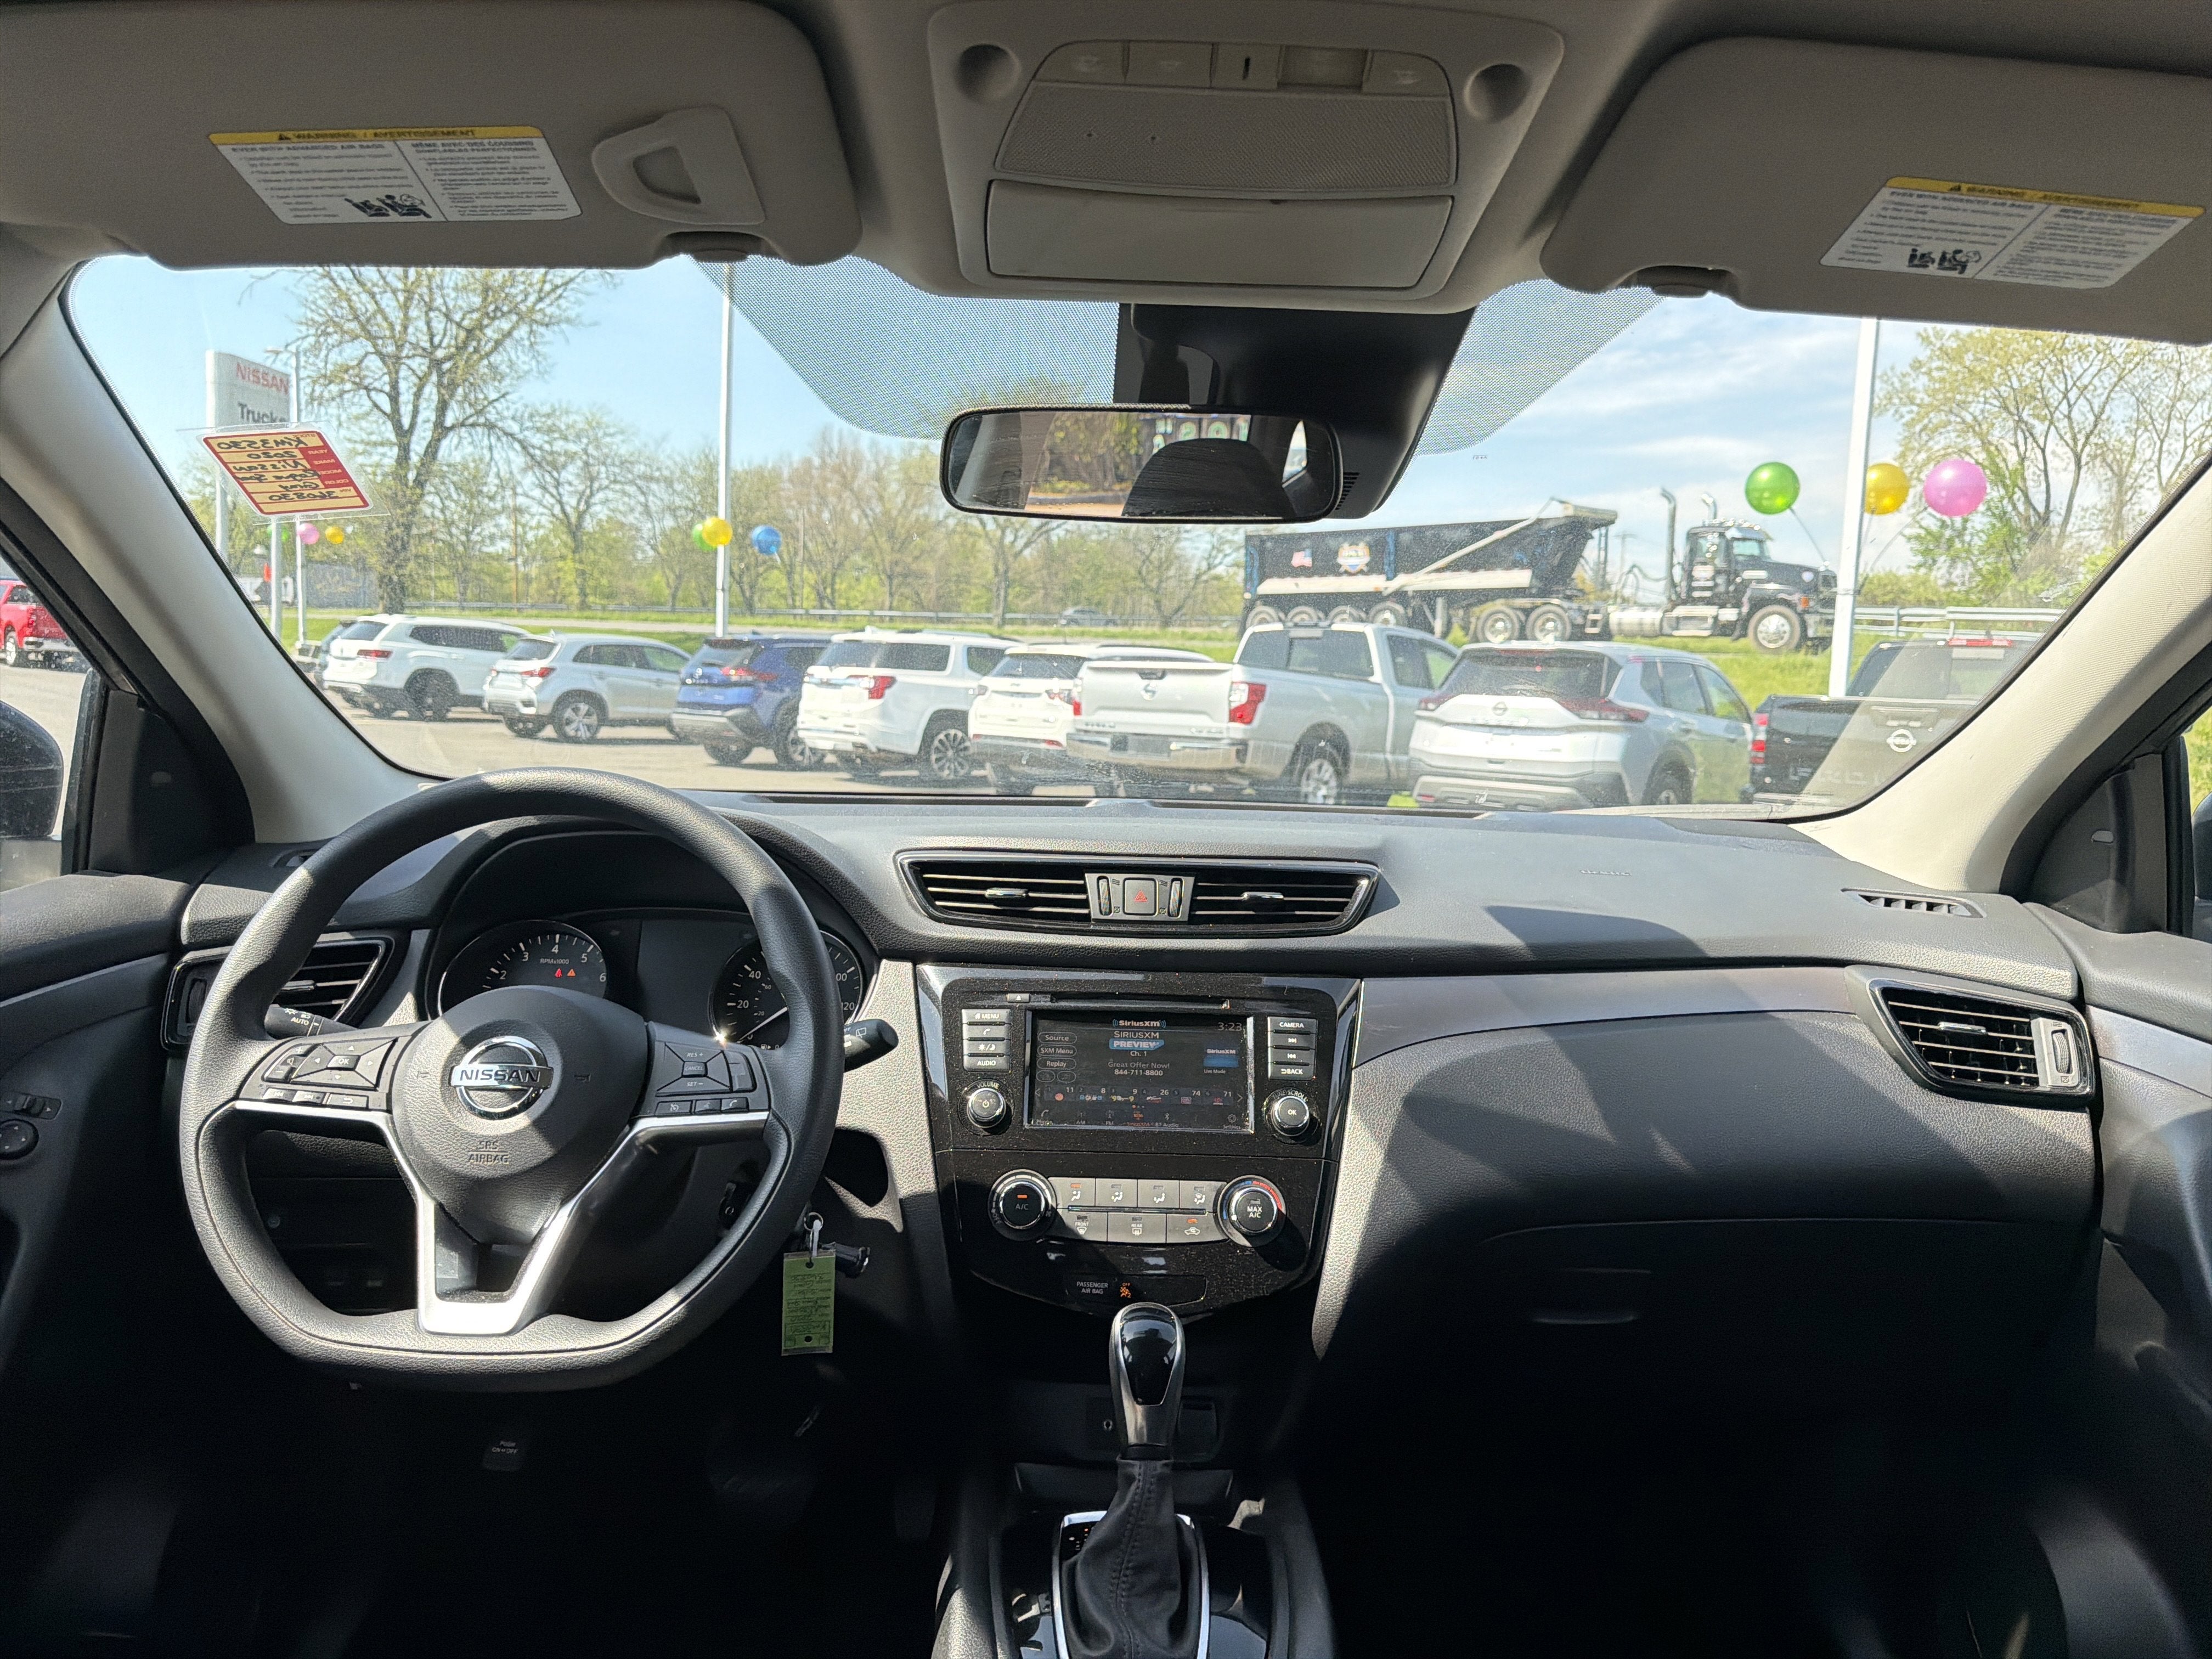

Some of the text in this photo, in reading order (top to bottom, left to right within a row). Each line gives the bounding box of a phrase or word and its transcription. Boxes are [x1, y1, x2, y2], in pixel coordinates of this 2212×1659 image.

[236, 362, 290, 396] NISSAN
[551, 944, 559, 954] 4
[522, 952, 529, 962] 3
[581, 953, 588, 963] 5
[499, 970, 507, 980] 2
[600, 972, 606, 982] 6
[748, 970, 761, 979] 40
[836, 973, 848, 981] 00
[737, 1000, 749, 1008] 20
[290, 1017, 310, 1026] AUTO
[1217, 1022, 1243, 1031] 3:23
[1114, 1031, 1159, 1039] SIRIUSXM
[459, 1069, 541, 1083] NISSAN
[976, 1081, 1000, 1090] VOLUME
[478, 1140, 499, 1150] SRS
[468, 1153, 510, 1164] AIRBAG
